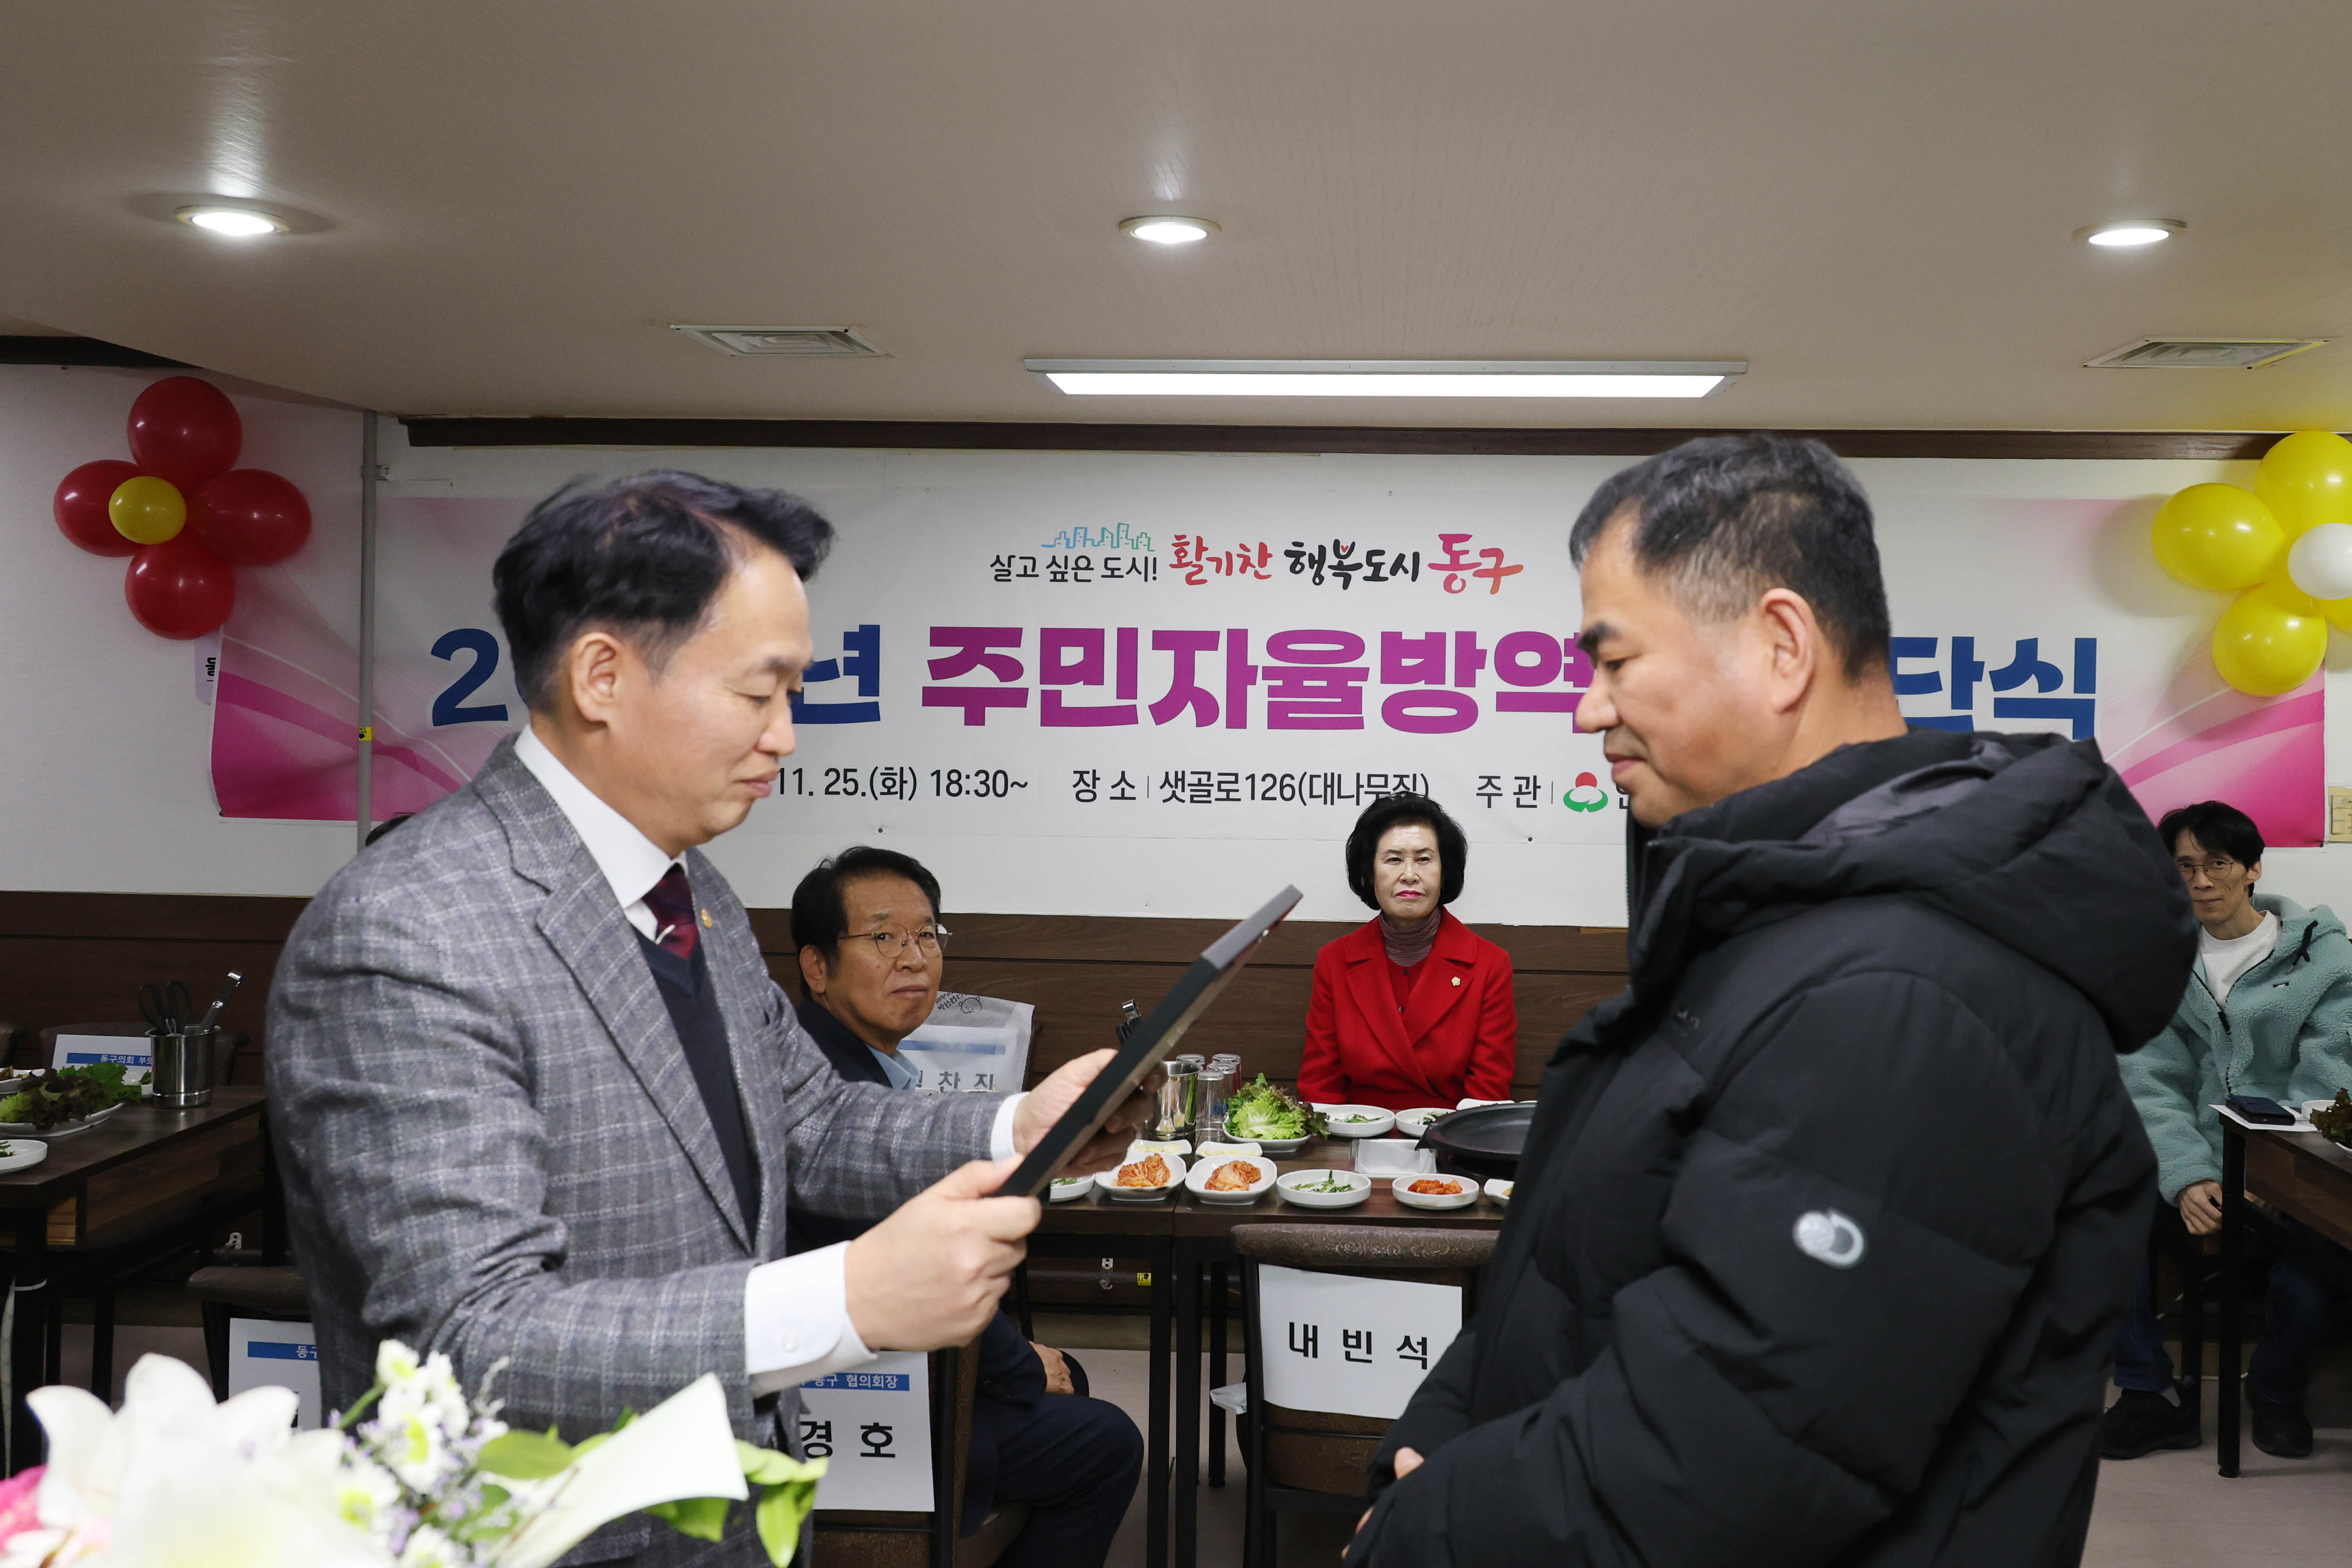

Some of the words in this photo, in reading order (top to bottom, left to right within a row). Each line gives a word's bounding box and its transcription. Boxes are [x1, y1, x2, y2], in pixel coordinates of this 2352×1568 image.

[990, 554, 1040, 582] 살고
[1046, 555, 1094, 583] 싶은
[1100, 556, 1157, 582] 도시!
[1169, 535, 1273, 586] 활기찬
[1284, 539, 1420, 590] 행복도시
[1427, 534, 1524, 595] 동구
[930, 769, 1028, 798] 18:30~
[846, 1374, 898, 1389] 협의회장
